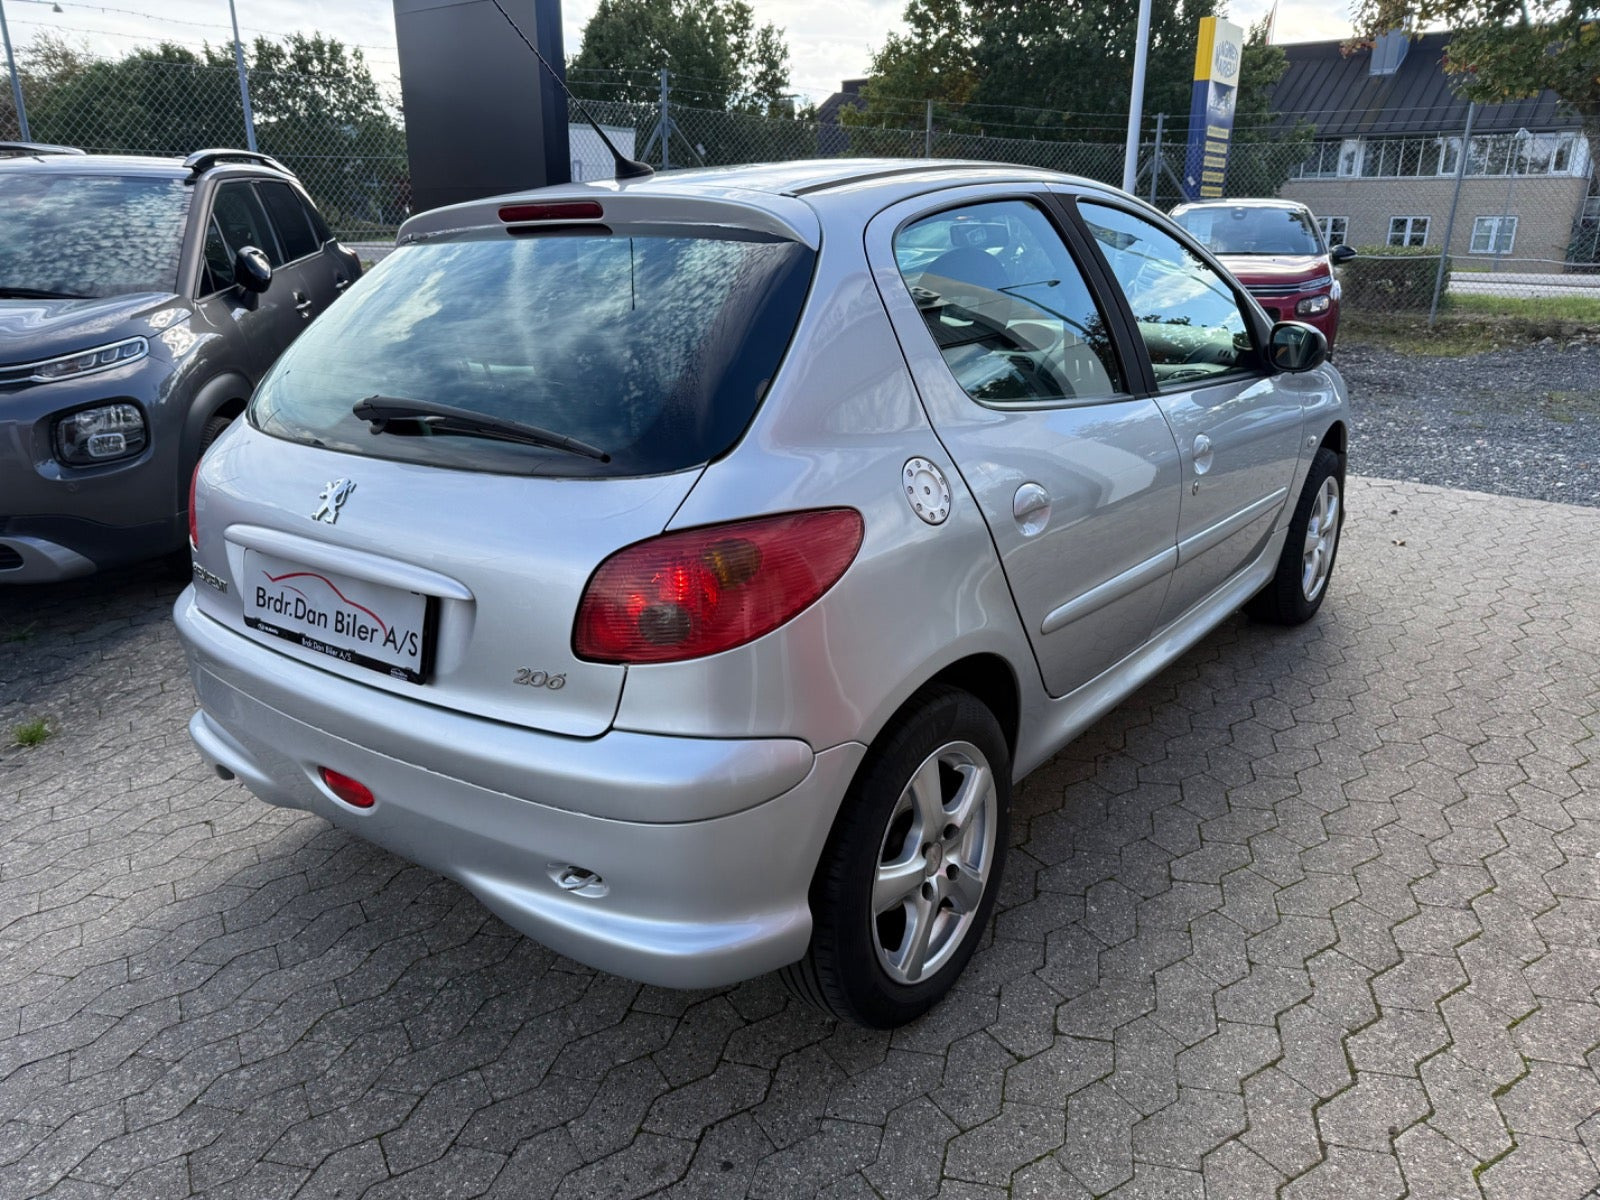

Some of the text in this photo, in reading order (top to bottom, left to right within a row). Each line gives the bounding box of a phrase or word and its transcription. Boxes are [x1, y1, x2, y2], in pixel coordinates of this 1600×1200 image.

[334, 610, 379, 643] Biler
[382, 625, 419, 657] A/S
[512, 666, 567, 690] 206
